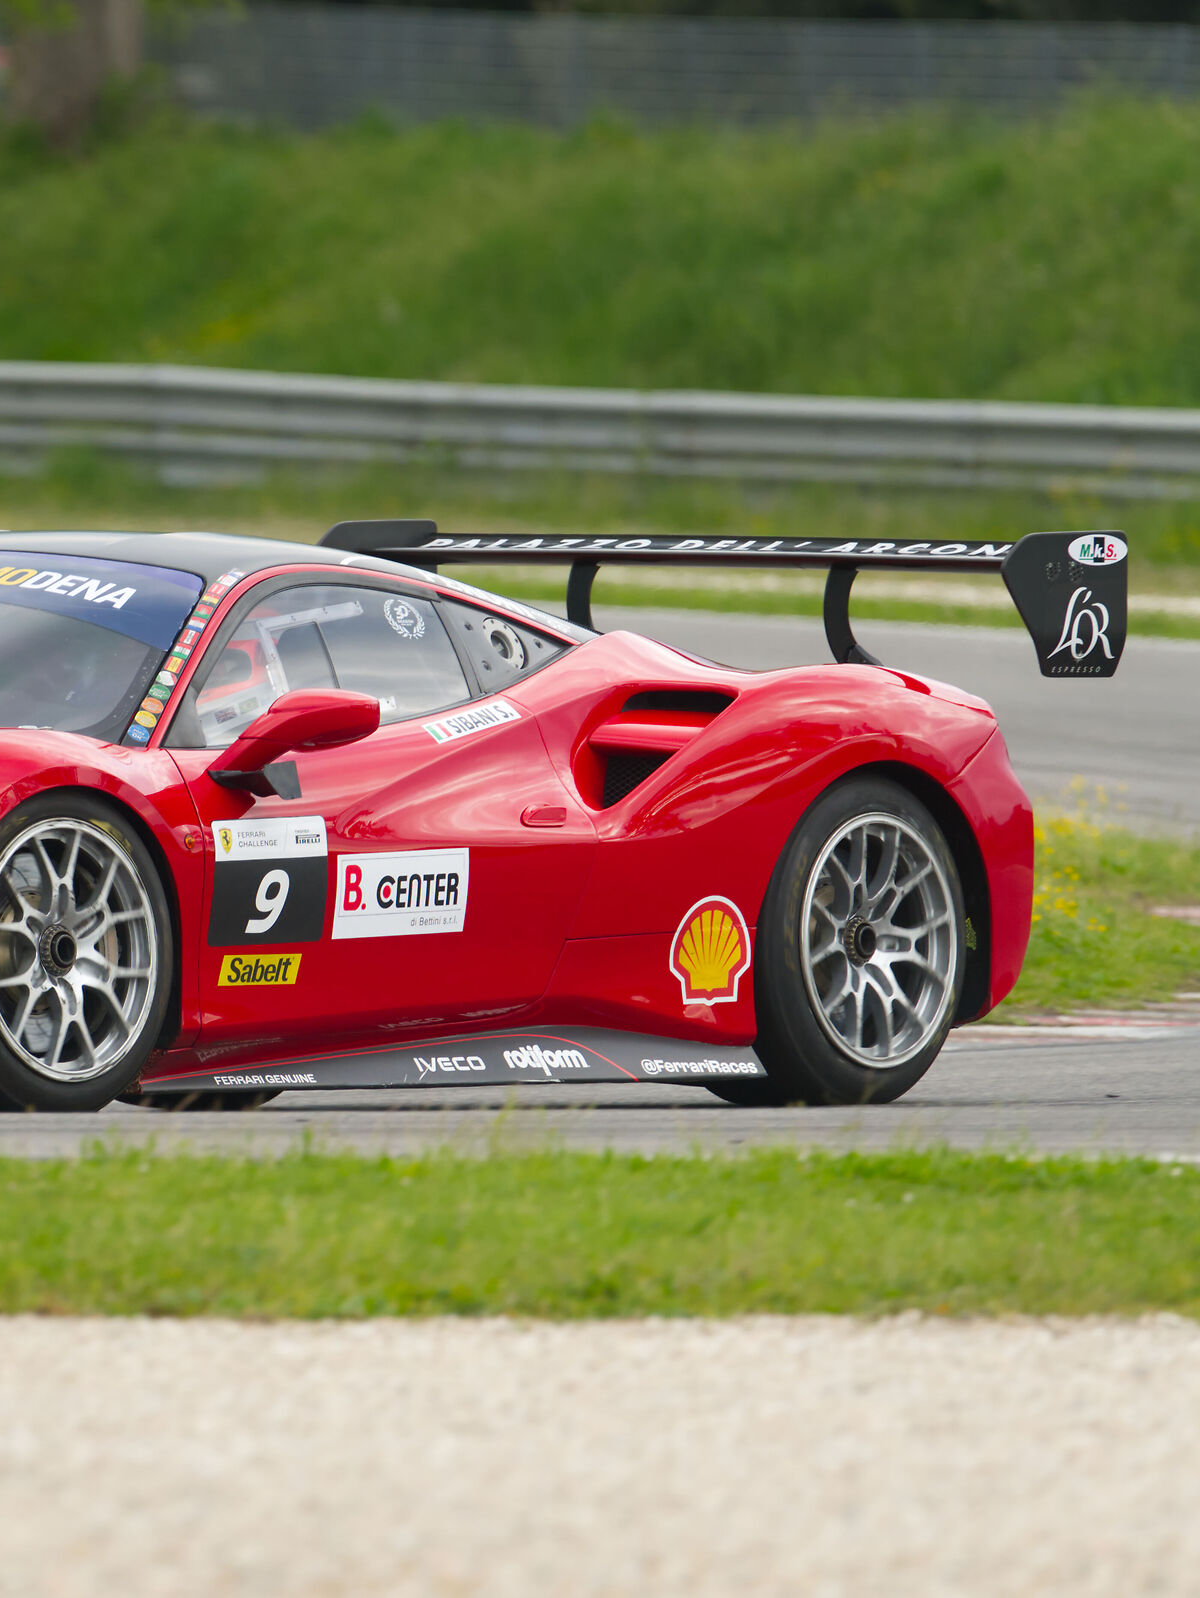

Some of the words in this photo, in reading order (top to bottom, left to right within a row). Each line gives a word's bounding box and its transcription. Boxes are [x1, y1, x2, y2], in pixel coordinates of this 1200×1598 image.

[419, 538, 651, 549] PALAZZO
[823, 542, 1014, 556] ARCON
[446, 708, 500, 733] SIBANI
[493, 705, 514, 719] S.
[238, 840, 278, 848] CHALLENGE
[295, 833, 321, 844] PIRELLI
[343, 865, 367, 911] B.
[376, 873, 459, 909] CENTER
[245, 869, 290, 934] 9
[419, 917, 441, 926] Bettini
[227, 957, 292, 983] Sabelt
[413, 1056, 486, 1072] IVECO
[503, 1045, 590, 1076] rotiform
[641, 1059, 758, 1075] @FerrariRaces
[214, 1074, 264, 1085] FERRARI
[265, 1074, 317, 1084] GENUINE
